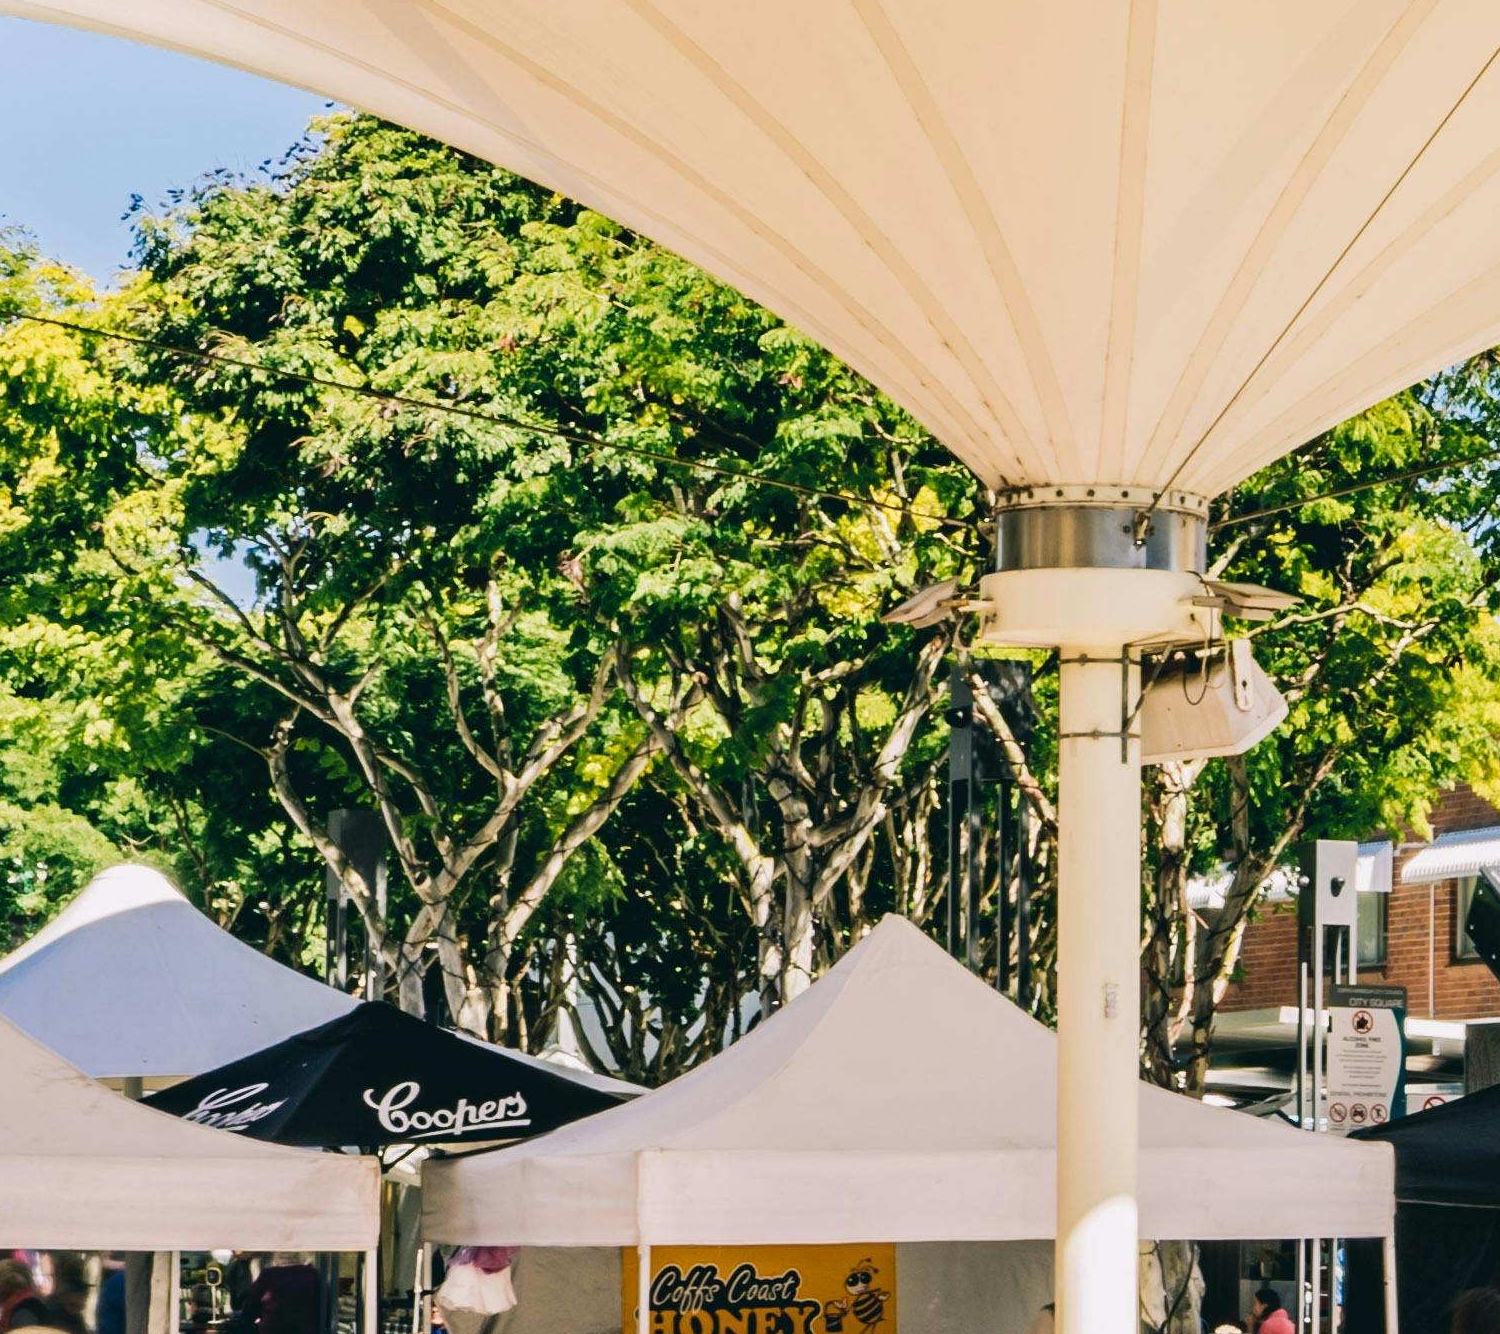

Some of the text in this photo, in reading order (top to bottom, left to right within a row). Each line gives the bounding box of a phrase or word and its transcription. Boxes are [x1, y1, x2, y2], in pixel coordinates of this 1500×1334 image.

[1370, 998, 1403, 1008] SQUARE
[362, 1081, 529, 1137] Coopers
[653, 1269, 797, 1315] Coffs Coast
